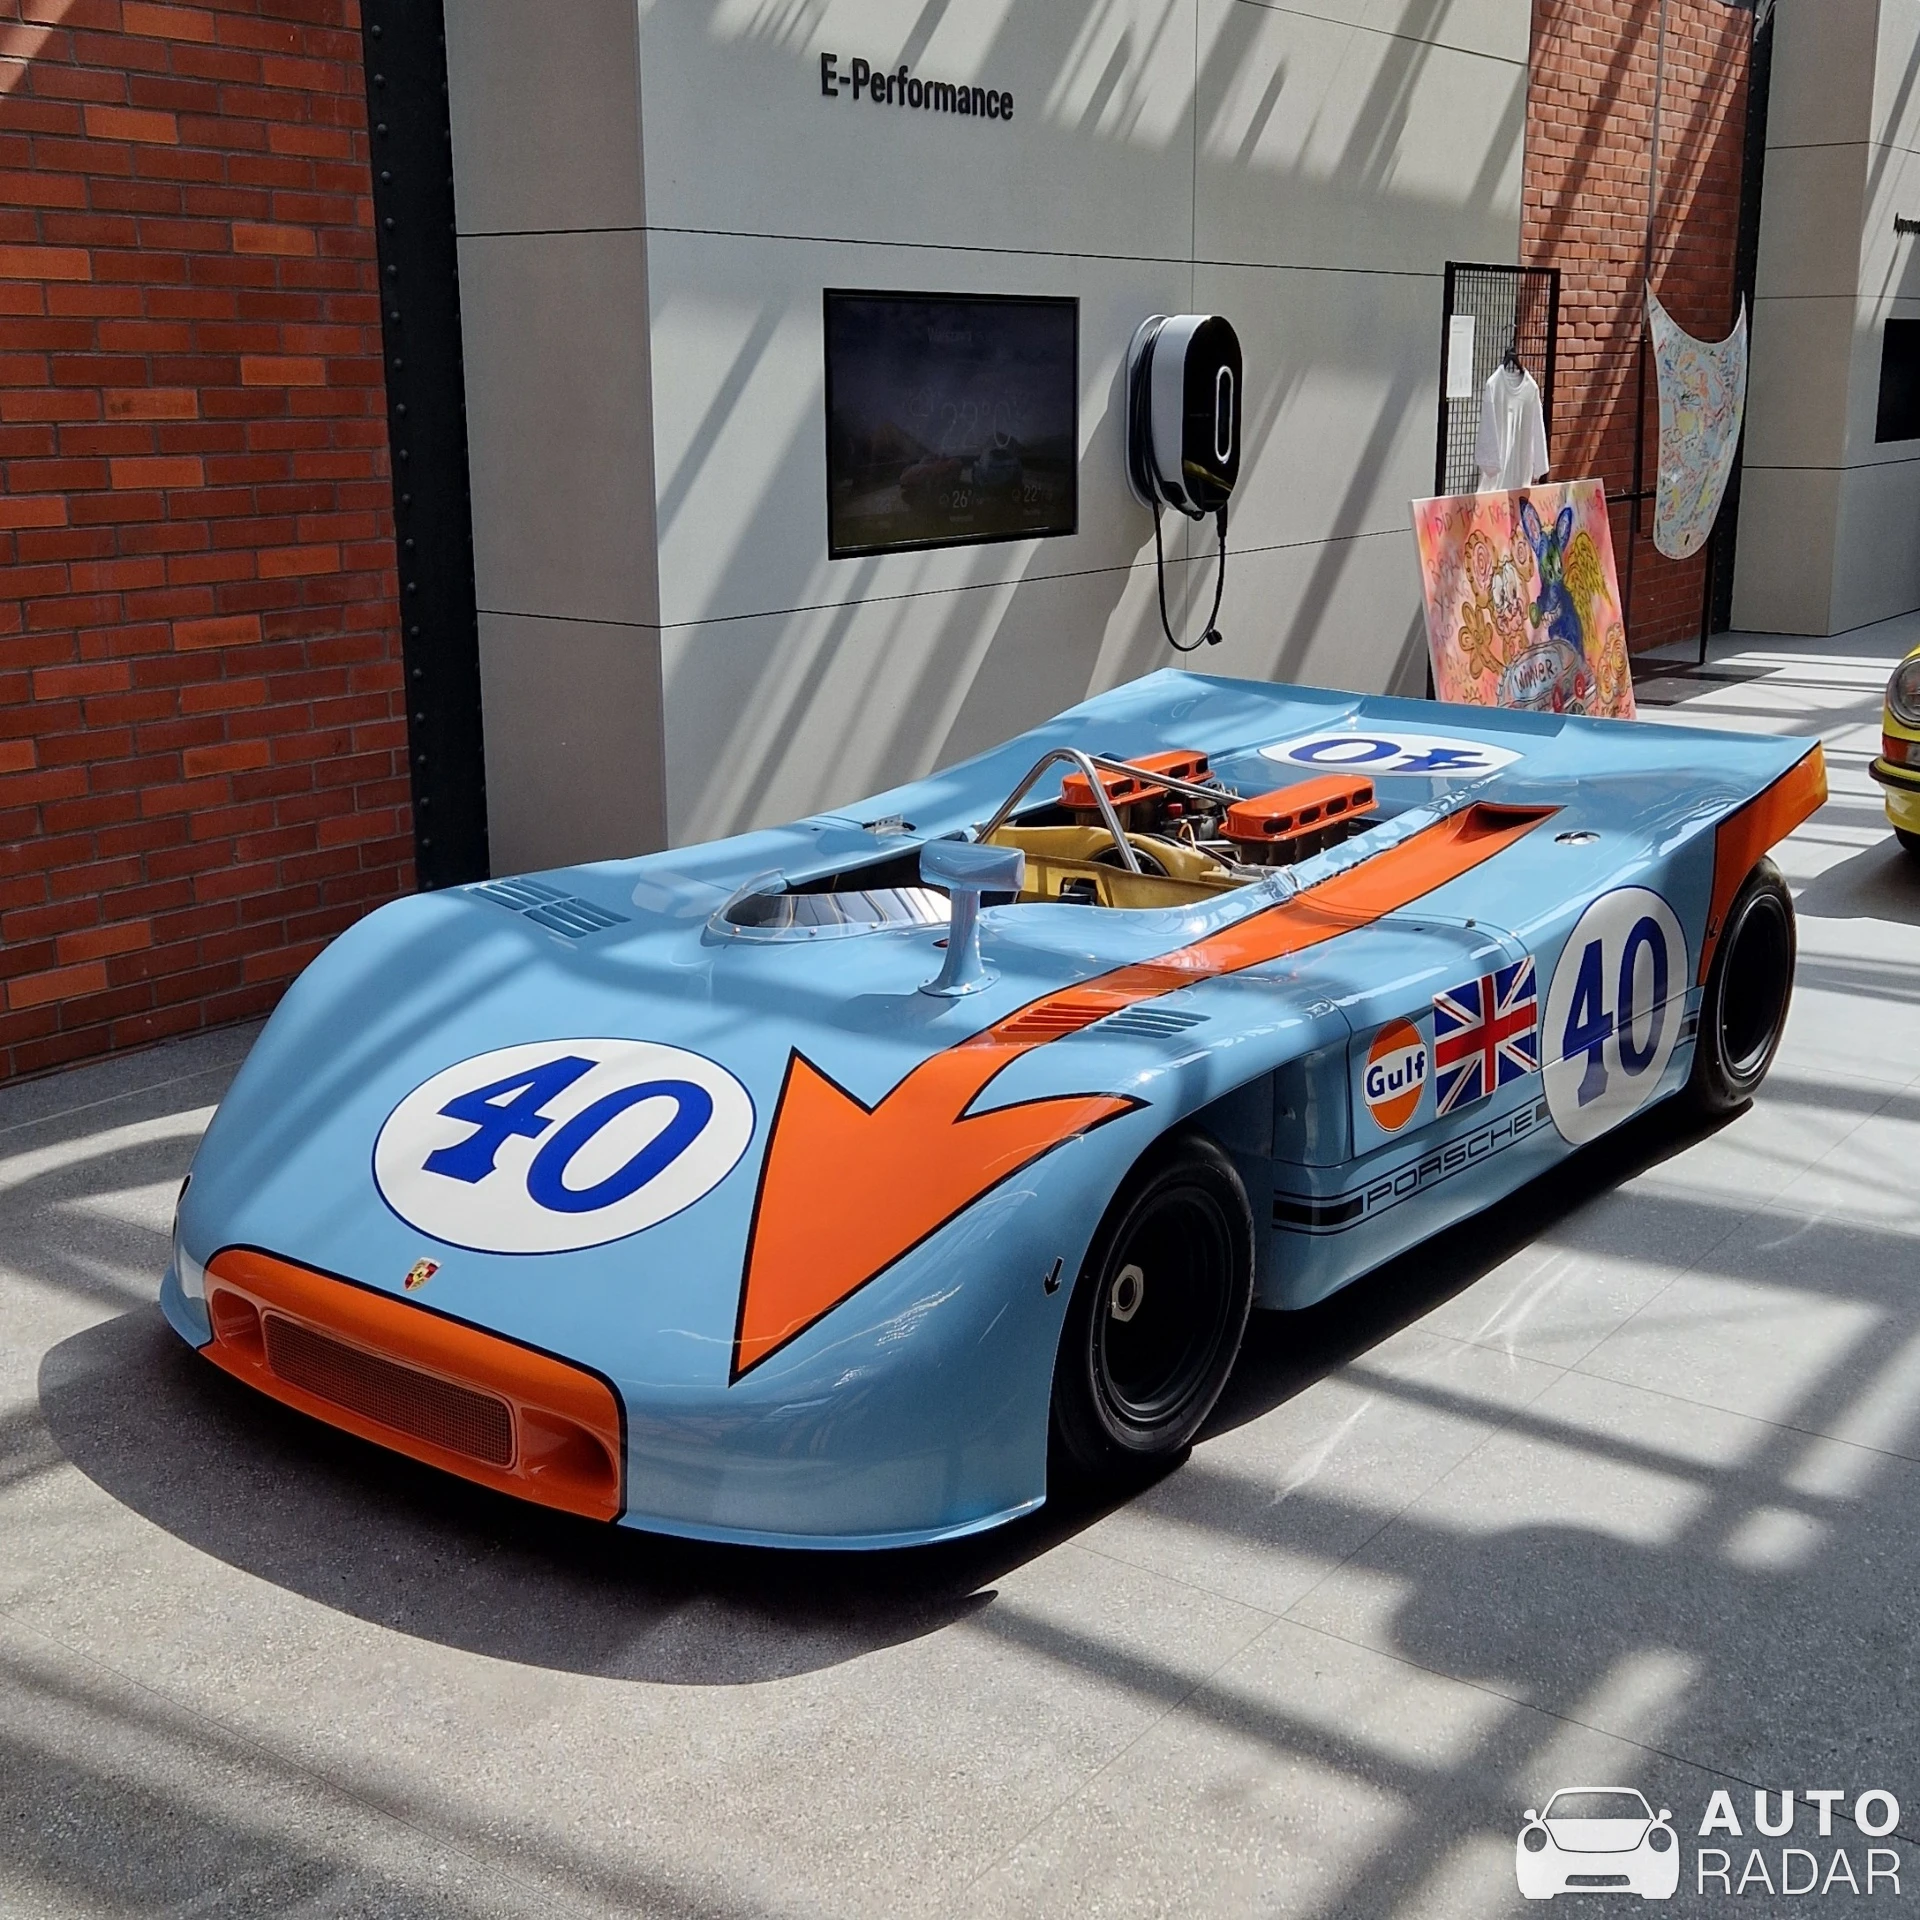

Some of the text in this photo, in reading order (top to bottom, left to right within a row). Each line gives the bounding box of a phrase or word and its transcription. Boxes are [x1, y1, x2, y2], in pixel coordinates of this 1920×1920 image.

[820, 51, 1014, 121] E-Performance
[1289, 738, 1493, 773] 40
[1562, 916, 1668, 1108] 40
[1366, 1050, 1425, 1098] Gulf
[421, 1055, 714, 1214] 40
[1366, 1108, 1533, 1211] PORSCHE
